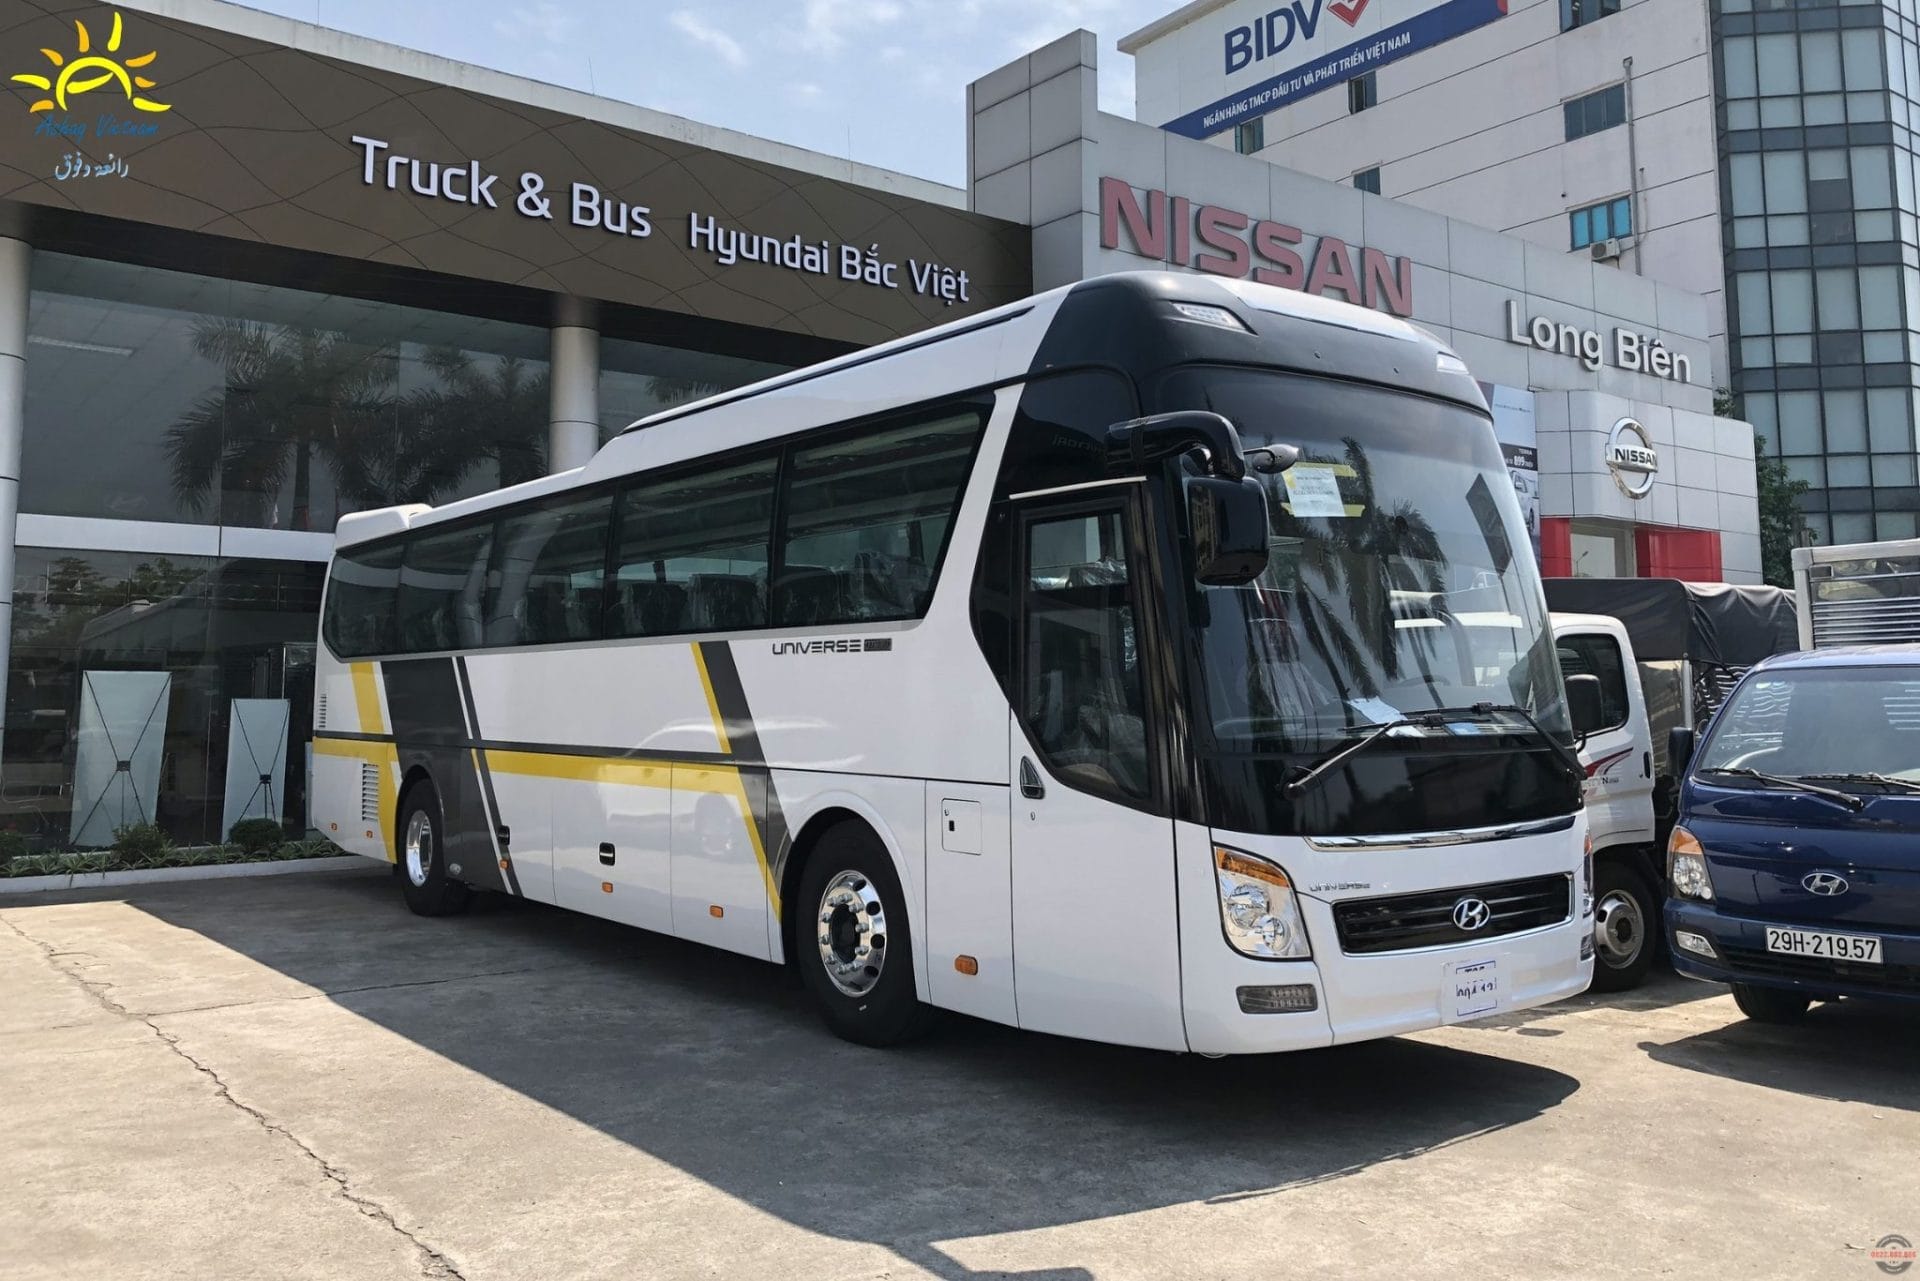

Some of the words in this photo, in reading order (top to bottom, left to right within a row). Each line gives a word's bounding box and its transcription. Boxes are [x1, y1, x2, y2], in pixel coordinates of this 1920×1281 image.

[1203, 110, 1225, 128] NGÂN
[1225, 100, 1248, 118] HÀNG
[1248, 91, 1271, 109] TMCP
[1290, 76, 1303, 92] TƯ
[1303, 70, 1315, 87] VÀ
[1315, 62, 1338, 82] PHÁT
[1339, 48, 1365, 72] TRIỂN
[1366, 41, 1387, 60] VIỆT
[1387, 31, 1411, 52] NAM
[1224, 0, 1323, 76] BIDV
[351, 135, 499, 208] Truck
[516, 172, 553, 220] &
[571, 181, 651, 238] Bus
[689, 211, 830, 276] Hyundai
[840, 243, 899, 289] Bắc
[908, 258, 970, 307] Việt
[1100, 176, 1412, 318] NISSAN
[1506, 300, 1604, 372] Long
[1613, 327, 1692, 383] Biên
[1615, 448, 1658, 467] NISSAN
[772, 639, 862, 655] UNIVERSE
[1769, 930, 1877, 960] 29H-219.57
